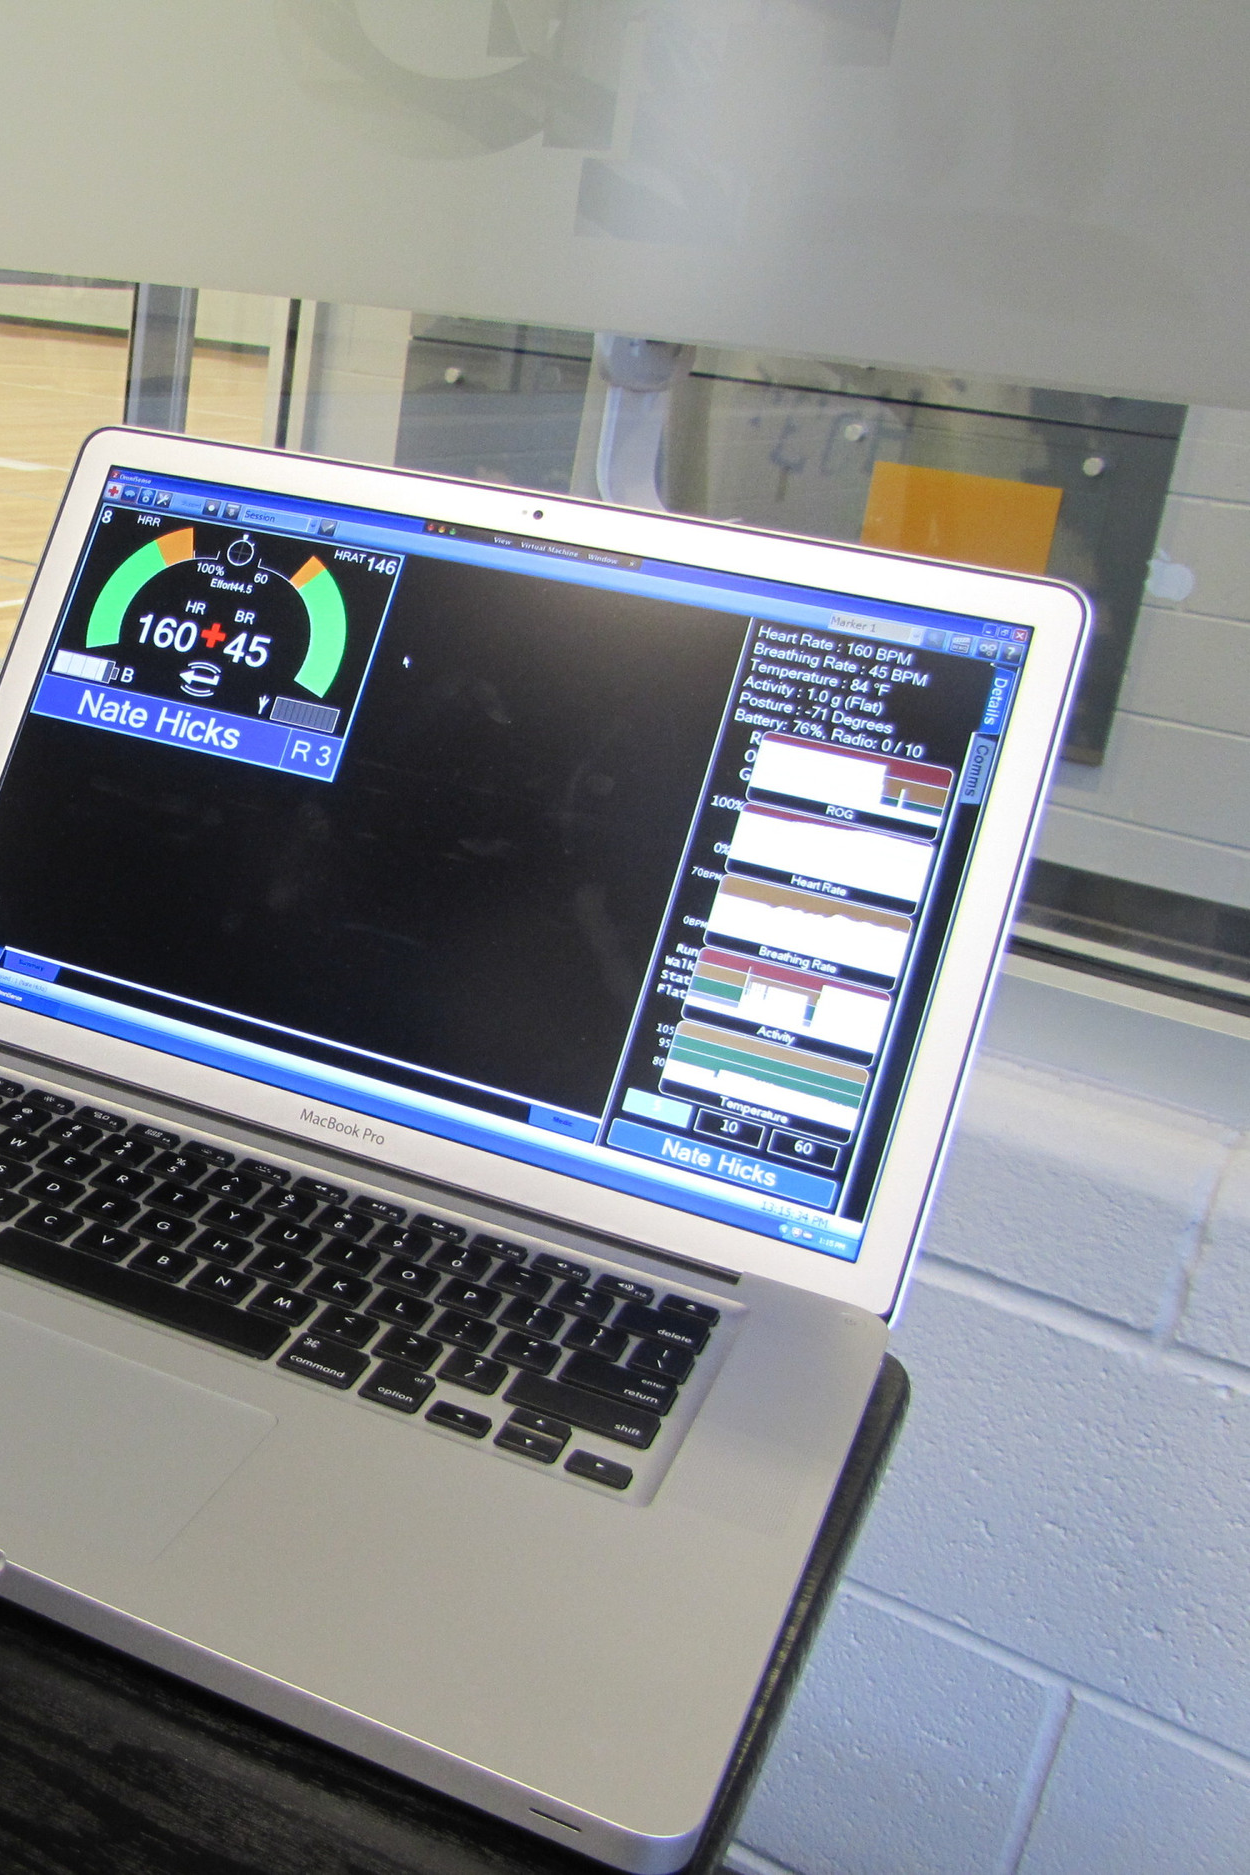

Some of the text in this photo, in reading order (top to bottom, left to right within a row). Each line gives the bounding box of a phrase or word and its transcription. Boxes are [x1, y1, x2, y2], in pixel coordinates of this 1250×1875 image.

[102, 509, 113, 524] 8
[137, 514, 162, 528] HRR
[244, 509, 276, 524] Session
[493, 536, 513, 547] View
[334, 549, 367, 565] HRAT
[519, 541, 579, 559] Virtual Machine
[367, 555, 398, 576] 146
[587, 552, 619, 566] Window
[195, 561, 226, 577] 100%
[253, 572, 269, 586] 60
[185, 600, 207, 616] HR
[234, 609, 256, 625] BR
[830, 614, 868, 632] Marker
[137, 612, 199, 654] 160
[222, 632, 272, 668] 45
[757, 625, 913, 667] Heart Rate 160 BPM
[753, 642, 928, 688] Breathing Rate 45 BPM
[119, 668, 135, 684] B
[750, 658, 838, 689] Temperature
[849, 679, 869, 694] 84
[743, 675, 883, 716] Activity 1.0 g (Flat)
[983, 676, 1009, 727] Details
[76, 688, 241, 751] Nate Hicks
[739, 691, 893, 735] Posture -71 Degrees
[734, 708, 787, 733] Battery:
[830, 727, 877, 749] Radio:
[881, 738, 891, 752] 0
[904, 744, 923, 759] 10
[290, 740, 333, 767] R 3
[964, 744, 989, 799] Comms
[710, 794, 744, 812] 100%
[825, 804, 854, 821] ROG
[691, 866, 723, 881] 70BPM
[790, 873, 847, 897] Heart Rate
[675, 943, 699, 958] Run
[664, 955, 695, 971] Walk
[758, 945, 837, 974] Breathing Rate
[660, 969, 692, 985] Stat
[656, 983, 687, 1000] Flat
[655, 1022, 675, 1037] 105
[756, 1025, 796, 1046] Activity
[658, 1037, 671, 1049] 95
[652, 1055, 665, 1068] 80
[719, 1095, 789, 1125] Temperature
[300, 1107, 386, 1146] MacBook Pro
[720, 1119, 739, 1134] 10
[10, 1137, 27, 1148] W
[794, 1140, 813, 1155] 60
[63, 1156, 77, 1165] E
[660, 1137, 777, 1188] Nate Hicks
[117, 1174, 129, 1184] R
[46, 1182, 60, 1192] D
[172, 1192, 184, 1201] T
[102, 1201, 115, 1210] F
[44, 1215, 58, 1225] C
[228, 1211, 241, 1220] Y
[156, 1221, 171, 1231] G
[101, 1234, 115, 1245] V
[283, 1230, 298, 1240] U
[213, 1240, 229, 1250] H
[156, 1255, 170, 1265] B
[273, 1261, 287, 1270] J
[215, 1275, 232, 1287] N
[402, 1270, 416, 1280] O
[333, 1280, 347, 1292] K
[273, 1296, 293, 1309] M
[463, 1291, 477, 1300] P
[395, 1302, 404, 1312] L
[657, 1328, 693, 1344] delete
[290, 1354, 346, 1378] command
[641, 1378, 666, 1390] enter
[377, 1386, 414, 1403] option
[623, 1388, 659, 1405] return
[614, 1422, 641, 1436] shift
